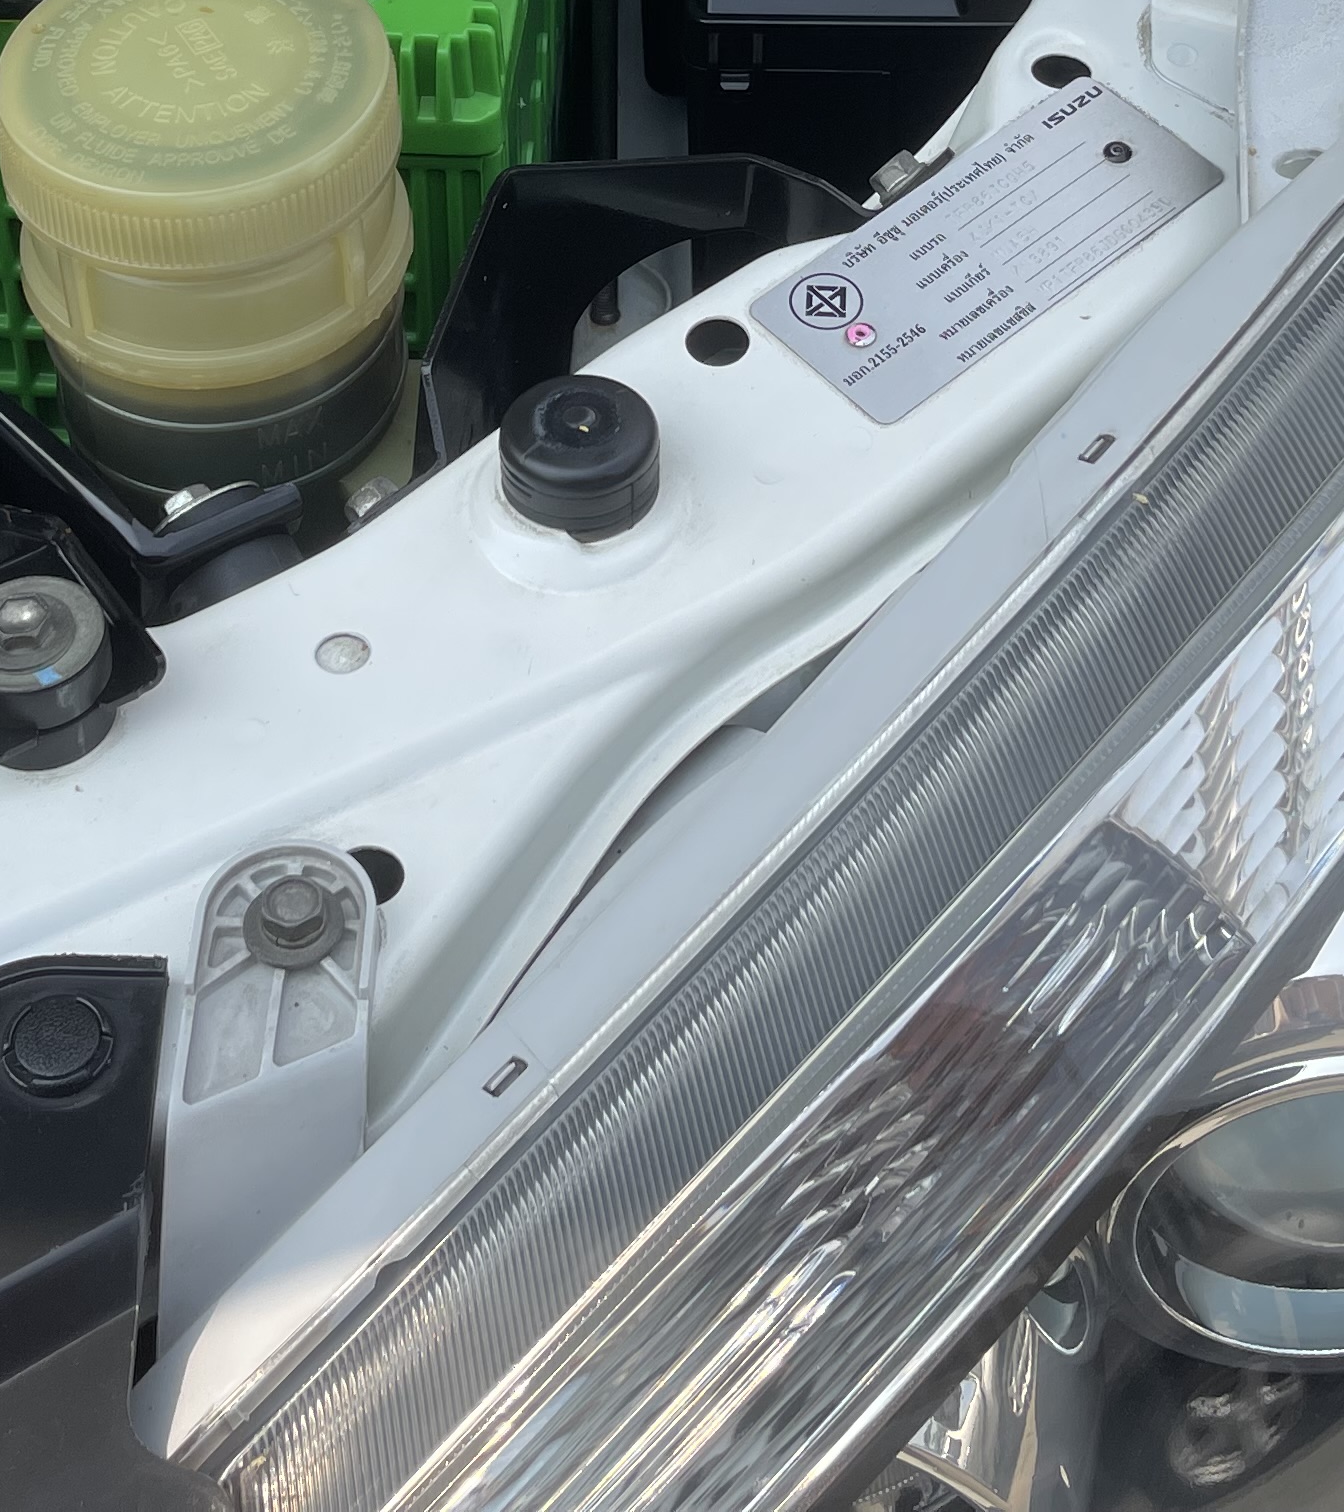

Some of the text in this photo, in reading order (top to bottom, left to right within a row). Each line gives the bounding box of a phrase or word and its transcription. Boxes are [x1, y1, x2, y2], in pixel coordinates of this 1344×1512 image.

[31, 25, 65, 72] FLUID.
[55, 20, 93, 98] APPROVED
[71, 101, 161, 146] EMPLOYER
[99, 82, 271, 124] ATTENTION
[1041, 81, 1104, 132] ISUZU
[49, 112, 77, 135] UN
[74, 129, 138, 164] FLUIDE
[268, 122, 297, 146] DE
[840, 239, 877, 271] บริษัท
[907, 229, 948, 263] แบบรถ
[910, 241, 970, 292] แบบเครื่อง
[940, 261, 992, 305] แบบเกียร์
[933, 276, 1016, 344] หมายเลขเครื่อง
[840, 320, 928, 389] มอก.2155-2546
[258, 405, 326, 451] MAX
[261, 441, 330, 484] MIN
